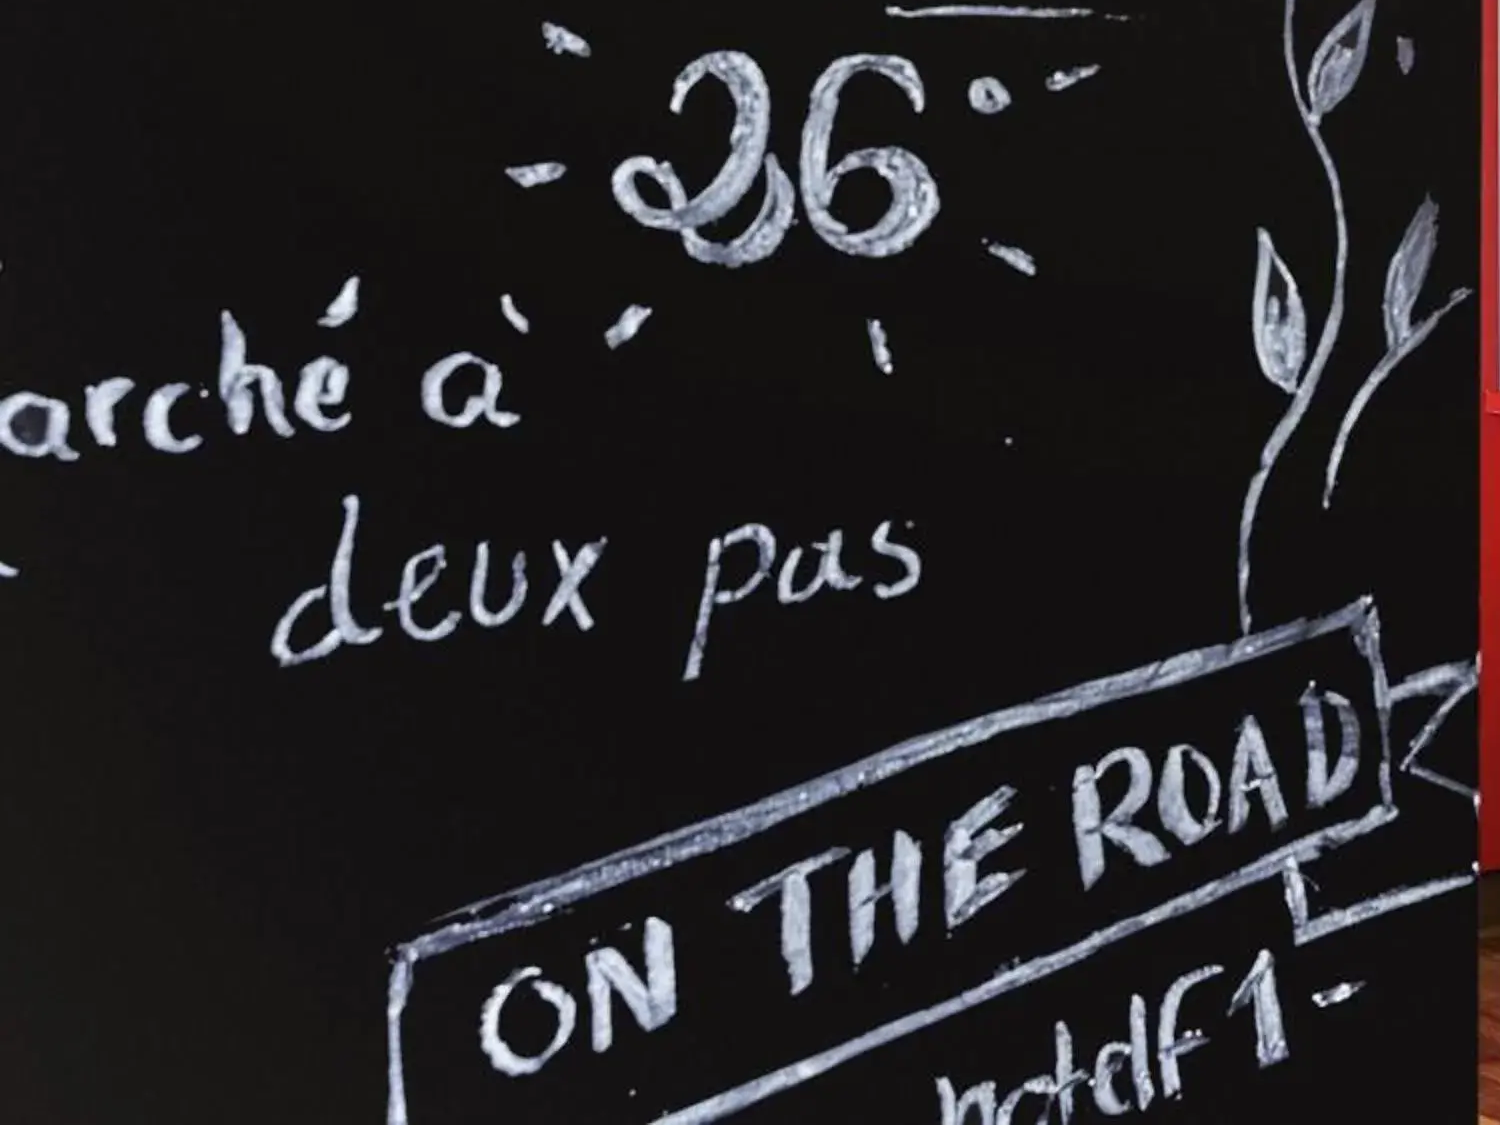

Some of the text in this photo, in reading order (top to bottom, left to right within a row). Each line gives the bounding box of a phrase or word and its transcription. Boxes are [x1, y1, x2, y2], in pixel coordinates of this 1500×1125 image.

[422, 294, 528, 427] à
[272, 495, 920, 679] deux pas
[480, 679, 1362, 1076] ON THE ROAD
